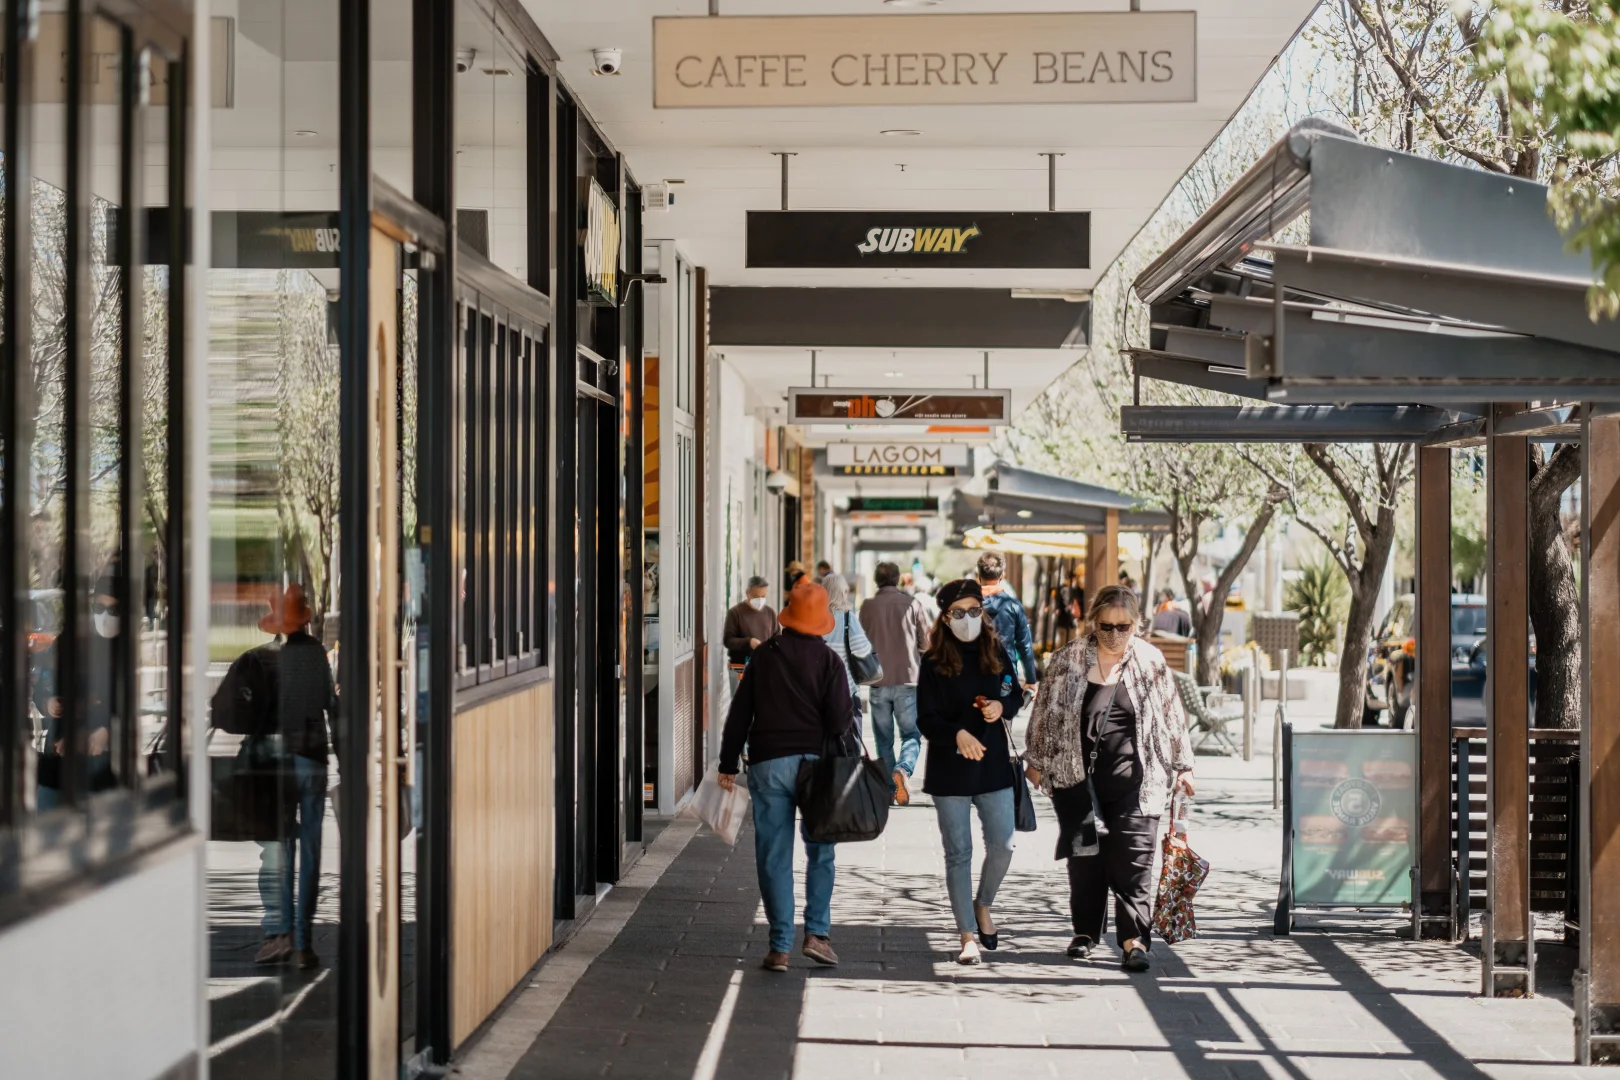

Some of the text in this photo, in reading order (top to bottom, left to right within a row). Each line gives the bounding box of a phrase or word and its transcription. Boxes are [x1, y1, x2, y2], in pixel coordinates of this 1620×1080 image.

[675, 50, 1174, 88] CAFFE CHERRY BEANS
[856, 225, 981, 254] SUBWAY
[853, 445, 941, 463] LAGOM
